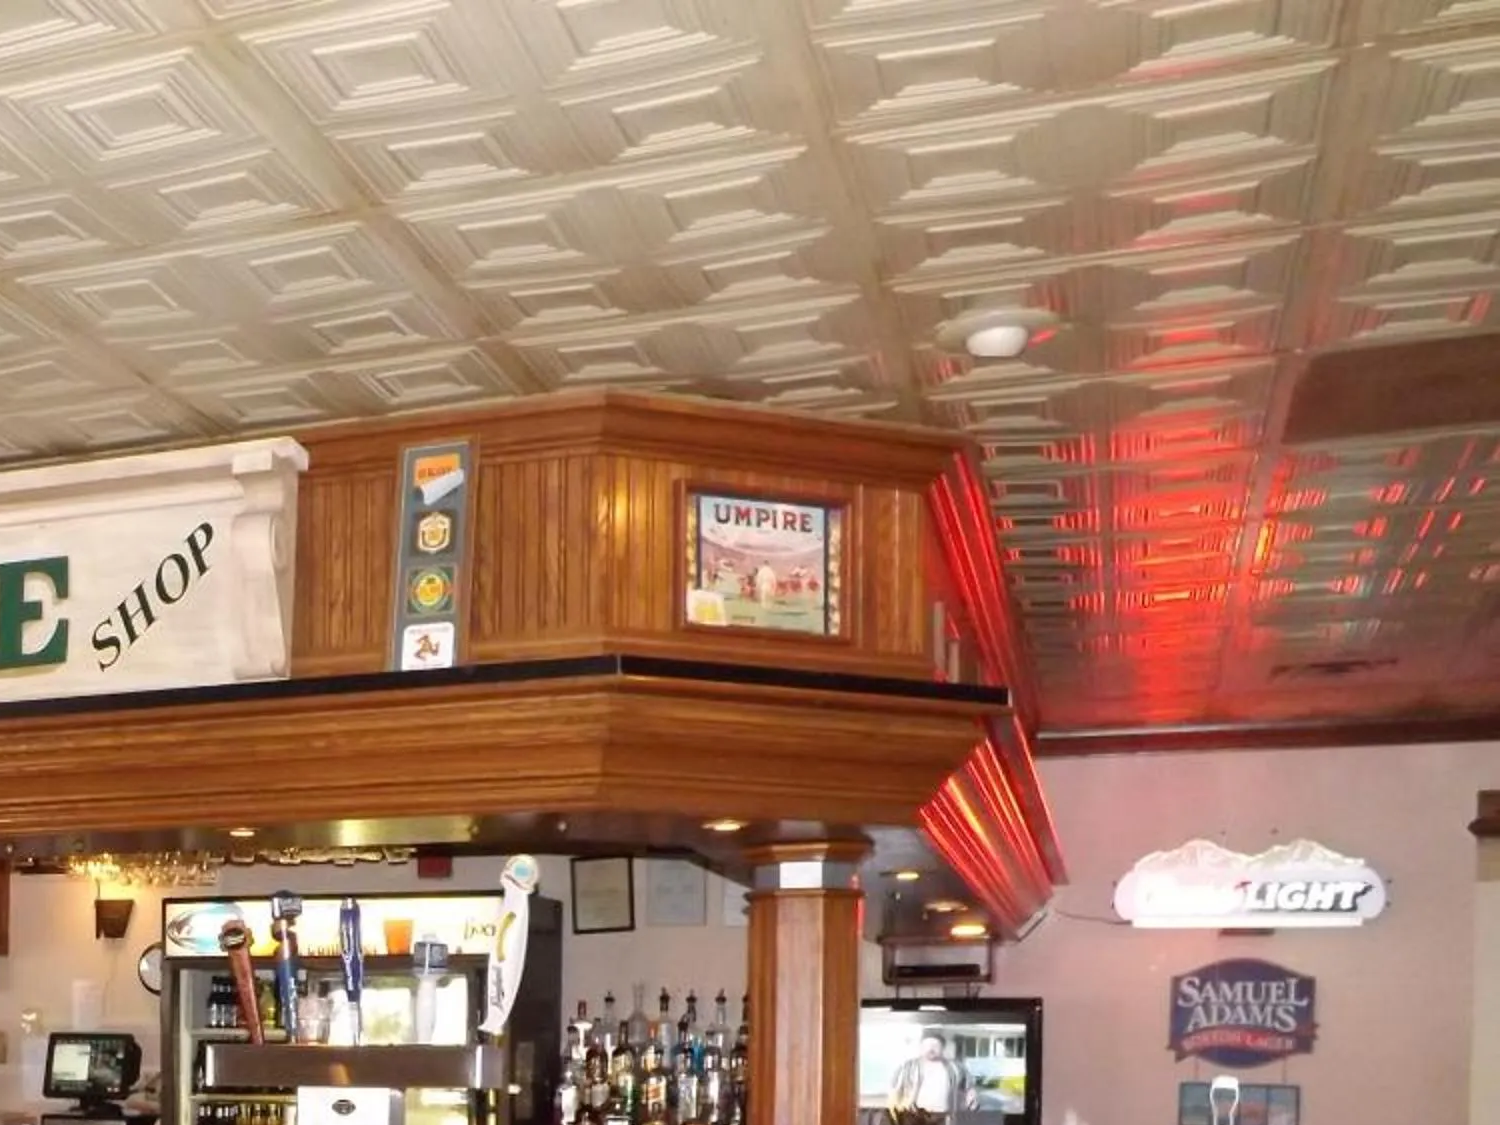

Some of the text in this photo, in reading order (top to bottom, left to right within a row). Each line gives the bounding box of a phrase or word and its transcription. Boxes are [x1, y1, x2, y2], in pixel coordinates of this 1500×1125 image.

[713, 503, 813, 533] UMPIRE
[91, 521, 214, 673] SHOP
[1242, 880, 1371, 913] LIGHT
[1177, 976, 1309, 1008] SAMUEL
[1186, 1004, 1298, 1033] ADAMS
